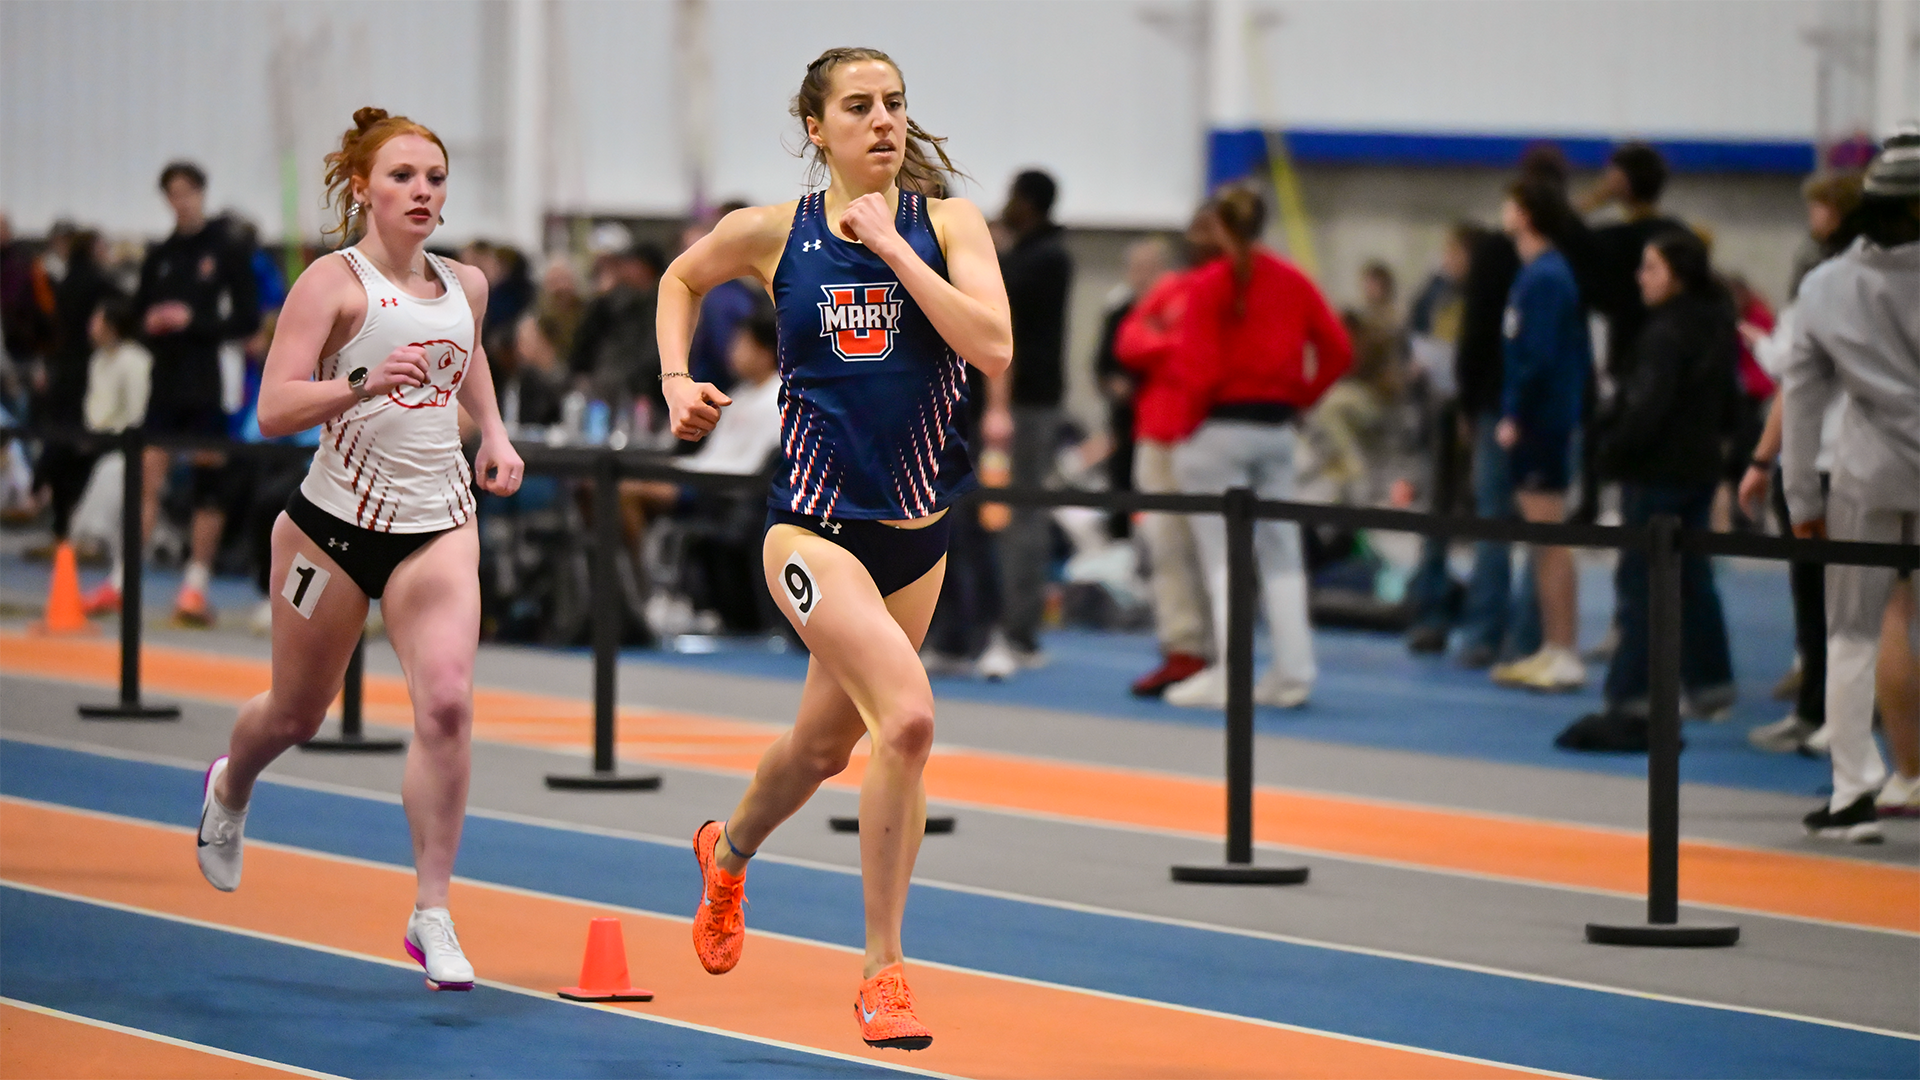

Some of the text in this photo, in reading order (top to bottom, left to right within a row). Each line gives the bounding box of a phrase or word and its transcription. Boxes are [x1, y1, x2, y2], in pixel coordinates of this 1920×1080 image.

[824, 303, 897, 332] MARY
[292, 566, 317, 609] 1
[784, 563, 813, 614] 9
